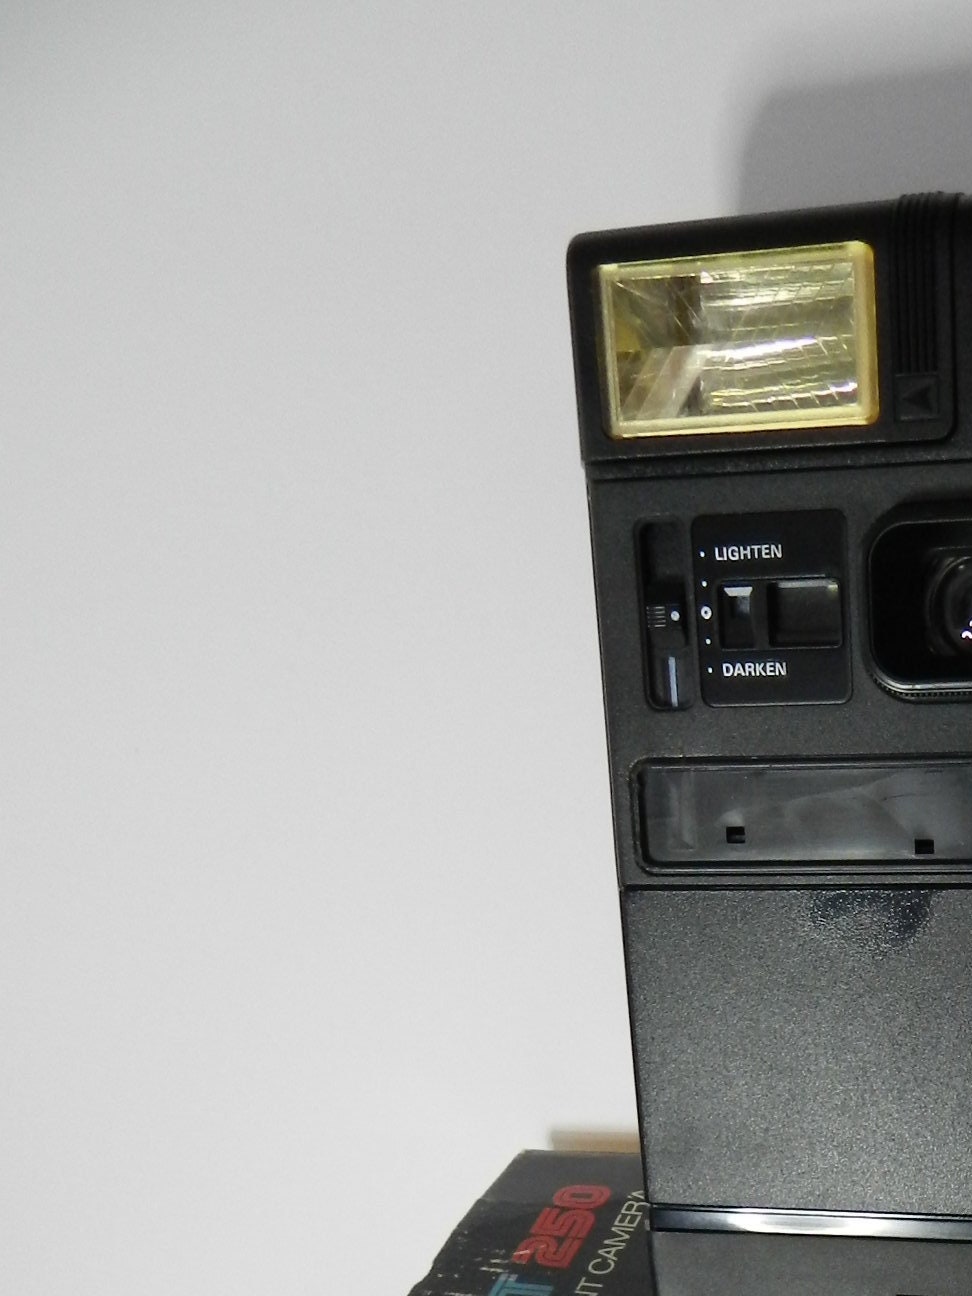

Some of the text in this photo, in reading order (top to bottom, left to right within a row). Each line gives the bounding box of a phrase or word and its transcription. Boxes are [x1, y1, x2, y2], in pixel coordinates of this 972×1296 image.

[714, 544, 783, 561] LIGHTEN
[722, 662, 787, 677] DARKEN
[510, 1184, 612, 1269] 250
